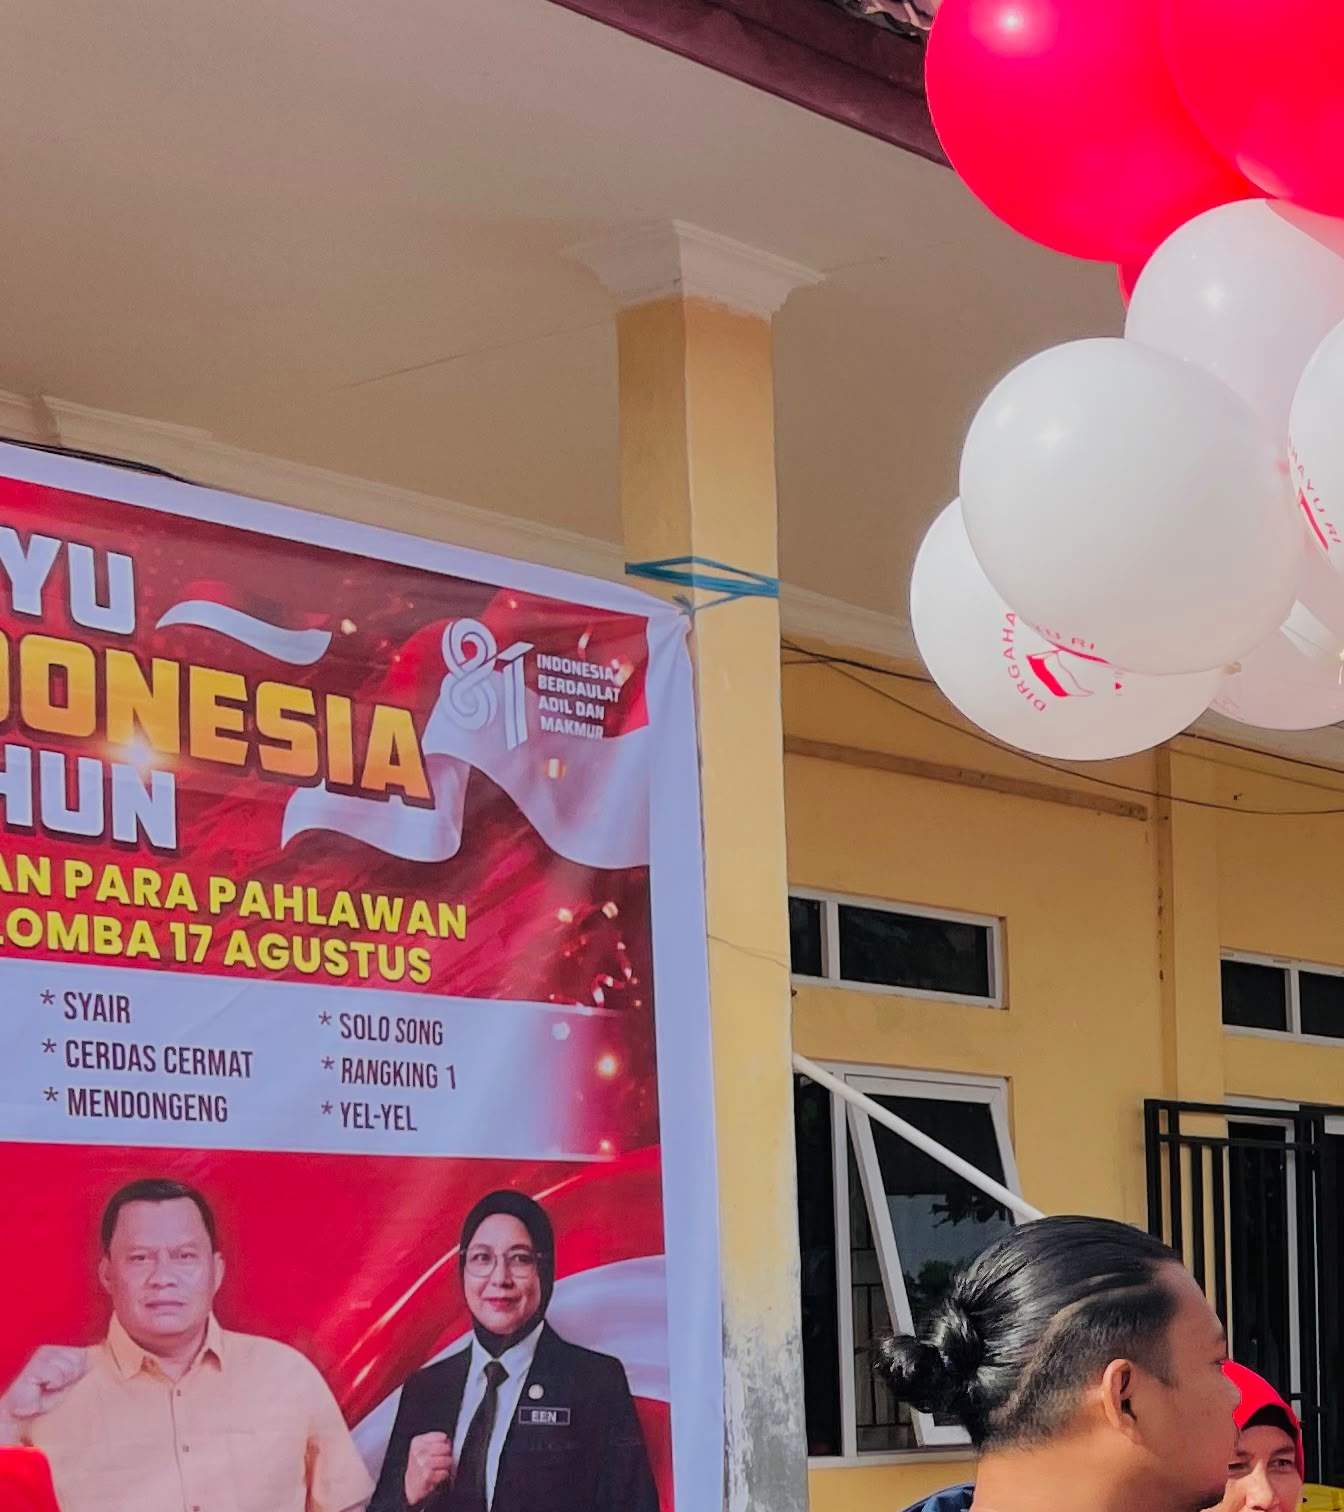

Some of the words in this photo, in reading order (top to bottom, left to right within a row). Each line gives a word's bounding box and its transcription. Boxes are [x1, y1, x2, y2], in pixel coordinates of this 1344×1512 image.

[0, 525, 136, 635] YU
[536, 653, 616, 681] INDONESIA
[537, 674, 621, 703] BERDAULAT
[0, 629, 433, 801] ONESIA
[538, 696, 573, 715] ADIL
[575, 700, 605, 721] DAN
[540, 716, 604, 740] MAKMUR
[64, 859, 199, 913] PARA
[208, 876, 468, 940] PAHLAWAN
[0, 907, 161, 960] OMBA
[169, 921, 213, 964] 17
[223, 929, 433, 985] AGUSTUS
[63, 991, 132, 1024] SYAIR
[339, 1012, 390, 1043] SOLO
[395, 1017, 444, 1047] SONG
[65, 1039, 157, 1073] CERDAS
[163, 1046, 254, 1079] CERMAT
[341, 1057, 438, 1090] RANGKING
[445, 1064, 457, 1091] 1
[67, 1087, 229, 1123] MENDONGENG
[340, 1101, 418, 1132] YEL-YEL
[531, 1410, 557, 1423] EEN
